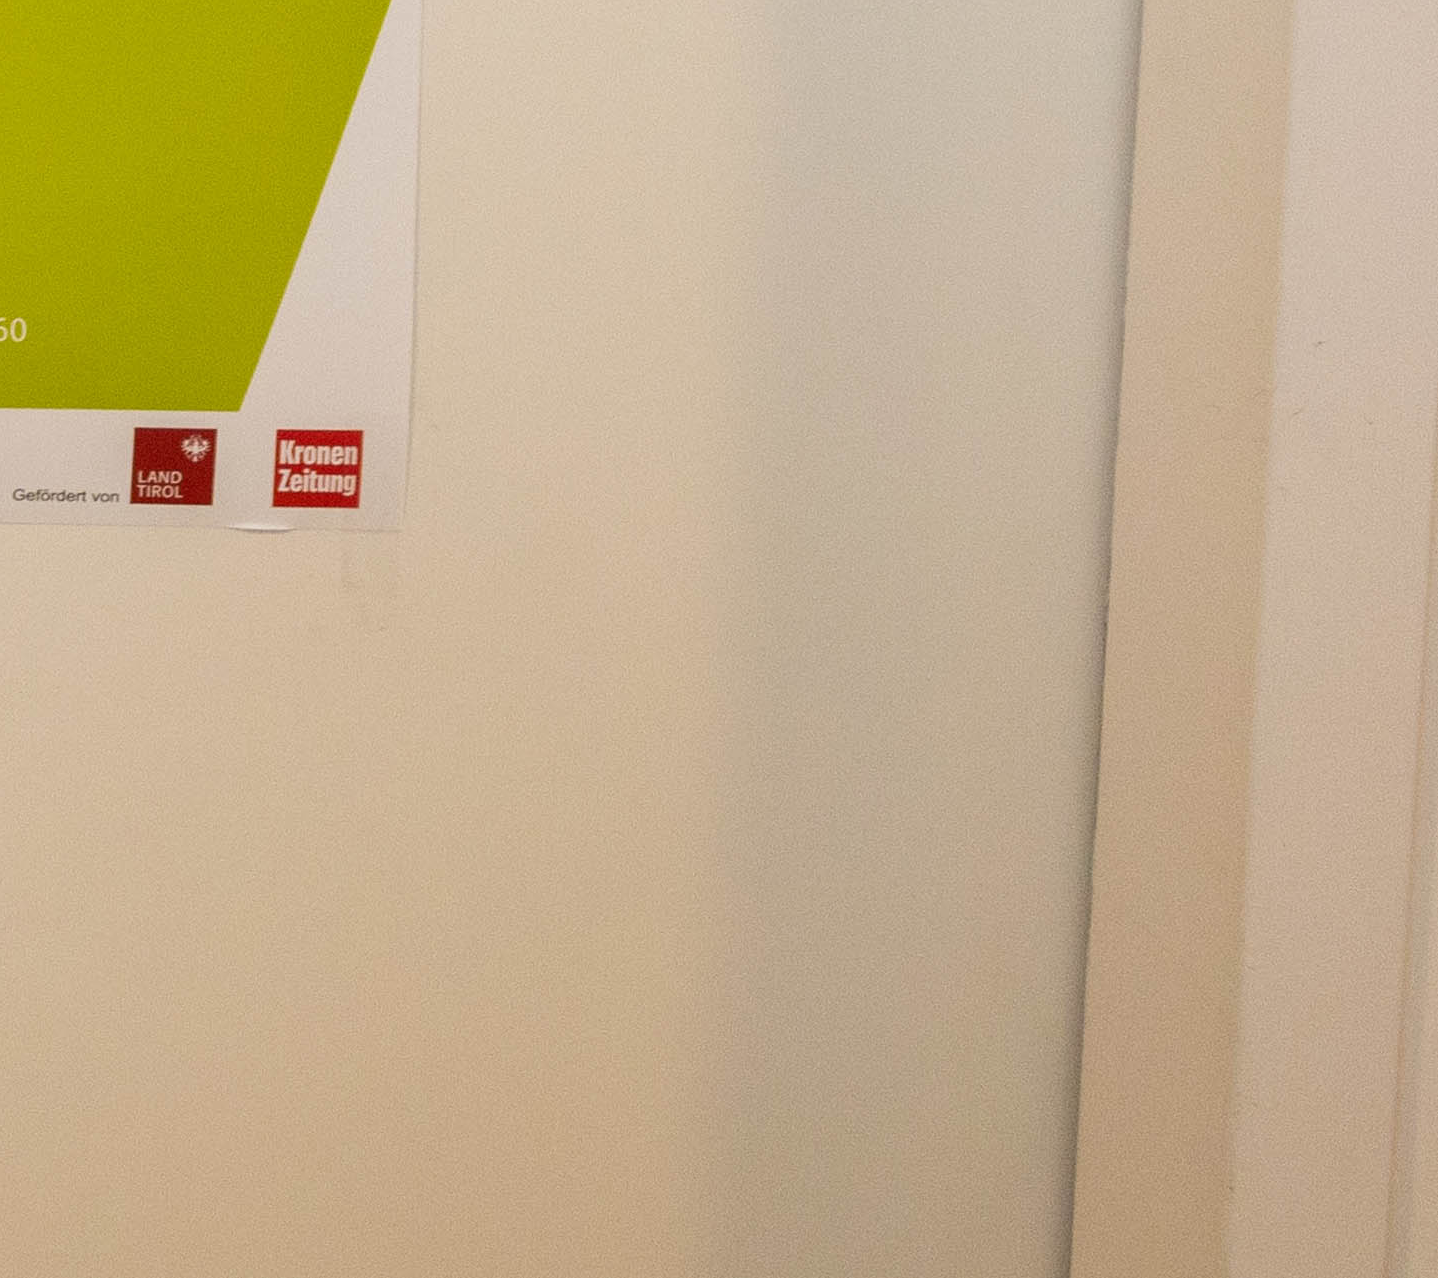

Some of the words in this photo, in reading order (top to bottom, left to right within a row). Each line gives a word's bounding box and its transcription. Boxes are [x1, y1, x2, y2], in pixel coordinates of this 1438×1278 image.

[278, 440, 358, 465] Kronen
[138, 471, 183, 484] LAND
[277, 469, 357, 496] Zeitung
[12, 488, 86, 503] Gefördert
[91, 492, 120, 503] von
[136, 485, 183, 498] TIROL
